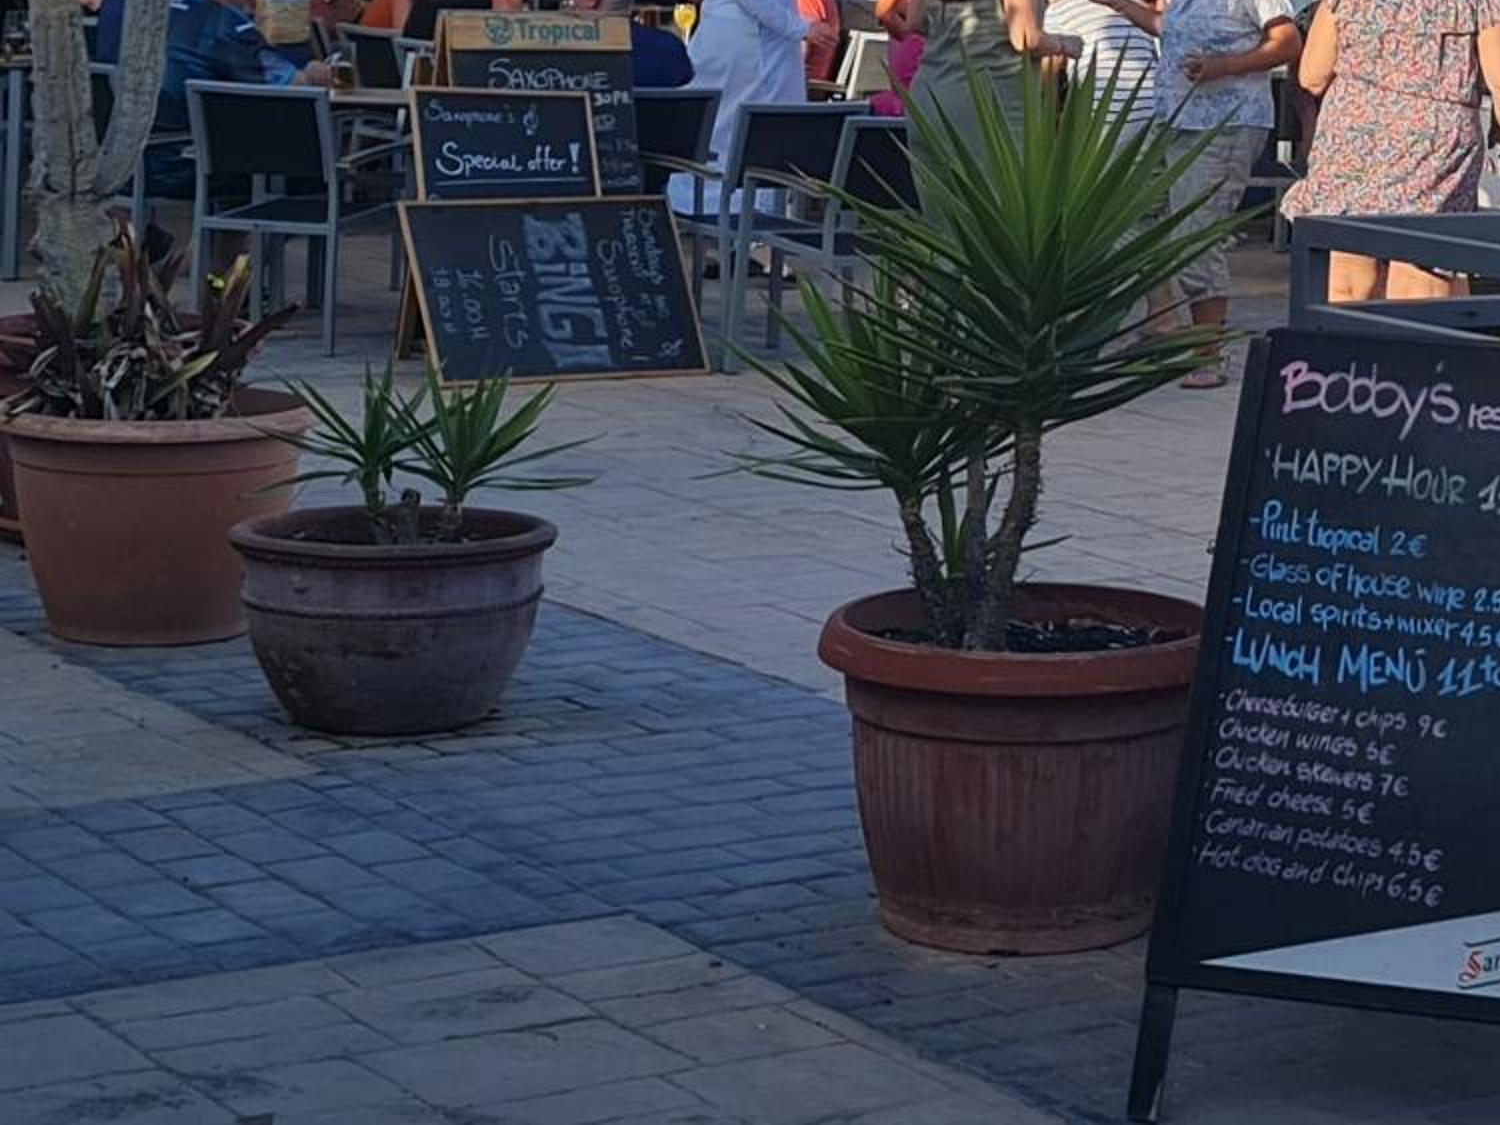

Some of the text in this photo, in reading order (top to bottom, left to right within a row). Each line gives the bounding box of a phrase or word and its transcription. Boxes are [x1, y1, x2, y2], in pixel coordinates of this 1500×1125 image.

[514, 18, 601, 44] Tropical
[435, 141, 523, 177] Special
[1279, 359, 1459, 442] Bobby's
[1271, 443, 1383, 494] HAPPY
[1380, 453, 1467, 506] HOUR
[1307, 508, 1380, 556] tropical
[1346, 564, 1412, 600] house
